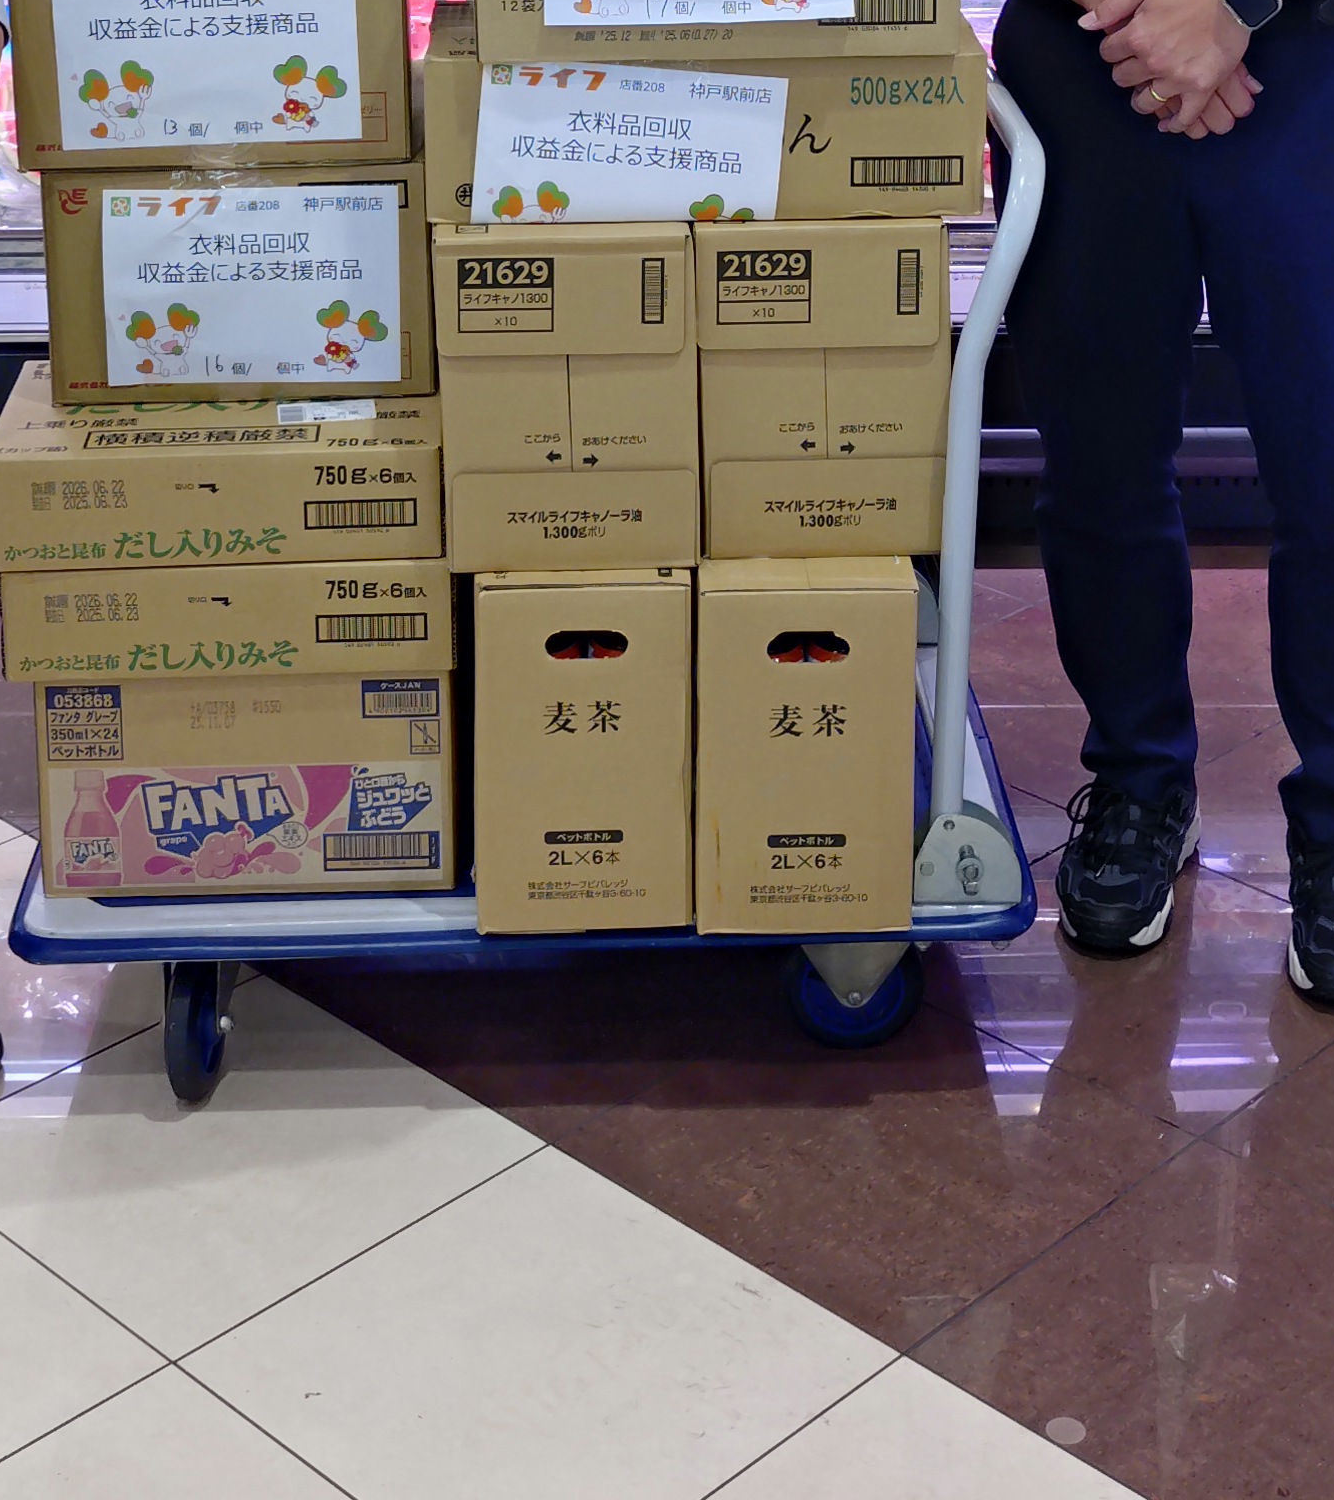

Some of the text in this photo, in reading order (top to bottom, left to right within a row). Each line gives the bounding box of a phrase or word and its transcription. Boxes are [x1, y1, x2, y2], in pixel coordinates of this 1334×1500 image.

[721, 0, 752, 15] 個中
[87, 12, 319, 41] 収益金による支援商品
[519, 66, 773, 105] ライフ 店番208 神戸駅前店
[164, 119, 178, 136] 13
[234, 120, 264, 136] 個中
[567, 110, 692, 141] 衣料品回収
[785, 113, 833, 155] ん
[510, 135, 742, 175] 収益金による支援商品
[137, 195, 384, 217] ライフ 店番208 神戸駅前店
[188, 232, 310, 256] 衣料品回収
[137, 259, 363, 285] 収益金による支援商品
[463, 260, 549, 286] 21629
[722, 252, 807, 279] 21629
[463, 292, 548, 305] ライフキャノ1300
[722, 283, 806, 297] ライフキャノ1300
[205, 355, 224, 374] 16
[276, 361, 305, 375] 個中
[94, 427, 310, 446] 横積逆積厳禁
[779, 421, 815, 433] ここから
[839, 422, 903, 434] おあけください
[524, 433, 561, 444] ここから
[582, 434, 647, 446] おあけください
[764, 497, 897, 513] スマイルライフキャノーラ油
[507, 508, 643, 524] スマイルライフキャノーラ油
[4, 527, 287, 562] かつおと昆布 だし入りみそ
[20, 640, 299, 672] かつおと昆布 だし入りみそ
[54, 693, 113, 708] 053868
[50, 710, 118, 723] ファンタ グレープ
[543, 700, 623, 735] 麦茶
[769, 704, 848, 738] 麦茶
[51, 744, 119, 758] ペットボトル
[144, 778, 291, 831] FANTA
[356, 783, 431, 809] ジュワッと
[360, 806, 406, 829] ぶどう
[555, 831, 612, 843] ペットボトル
[778, 835, 835, 847] ペットボトル
[71, 840, 114, 859] FANTA
